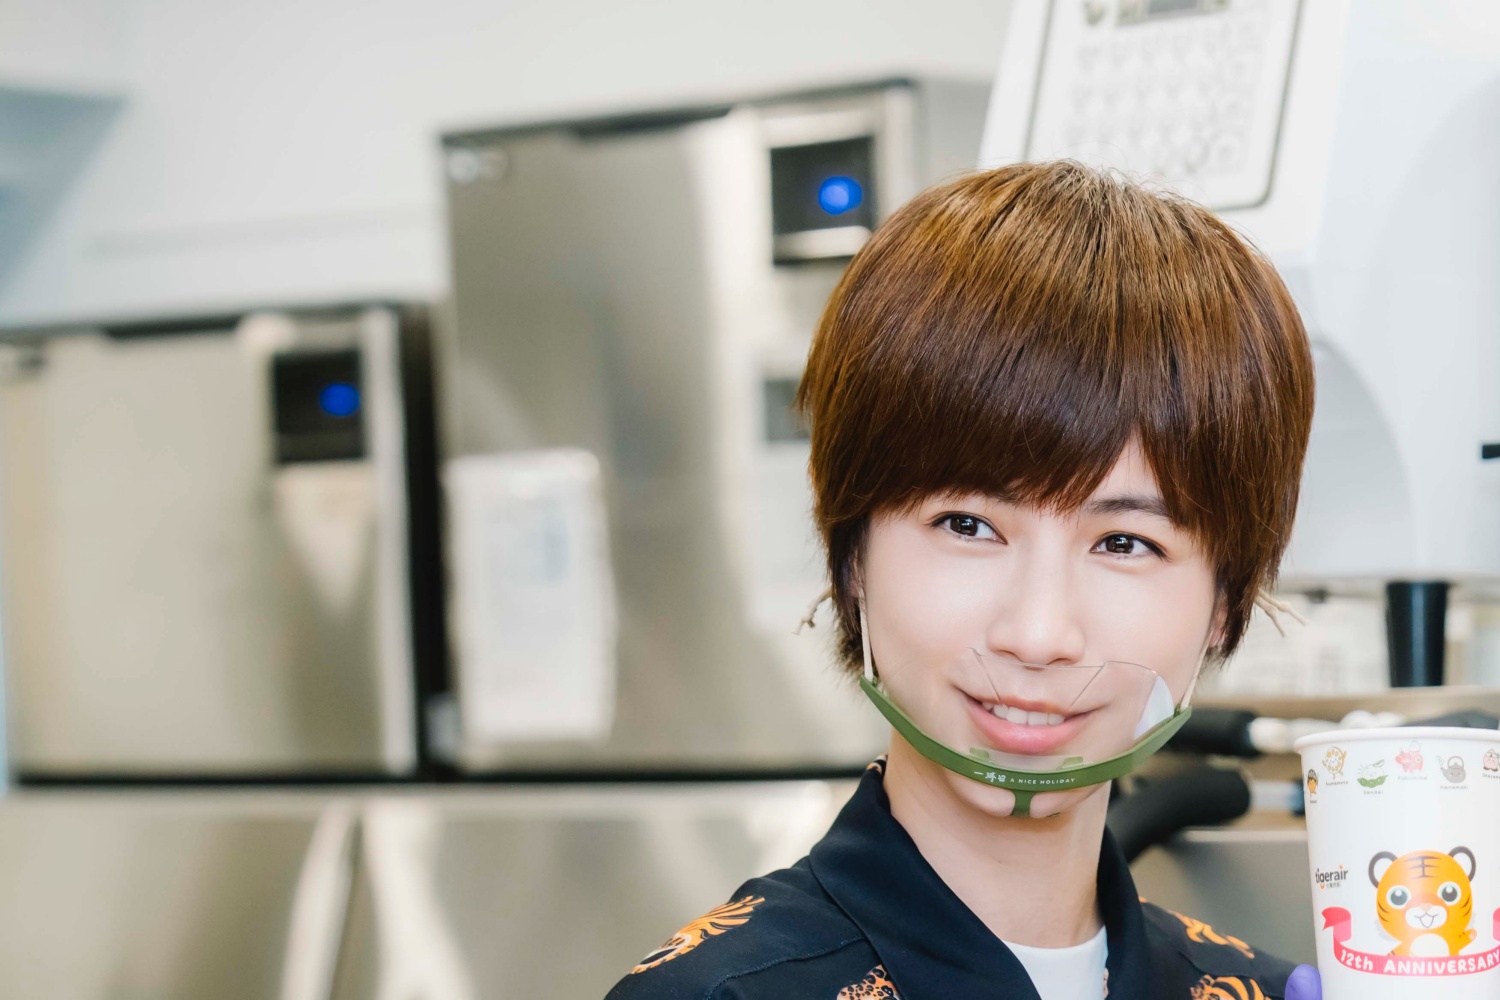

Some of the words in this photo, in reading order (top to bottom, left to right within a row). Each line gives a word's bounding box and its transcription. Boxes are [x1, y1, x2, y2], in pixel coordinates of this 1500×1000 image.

[1315, 864, 1349, 889] tigerair
[1339, 948, 1374, 972] 12th
[1383, 948, 1500, 975] ANNIVERSARY
